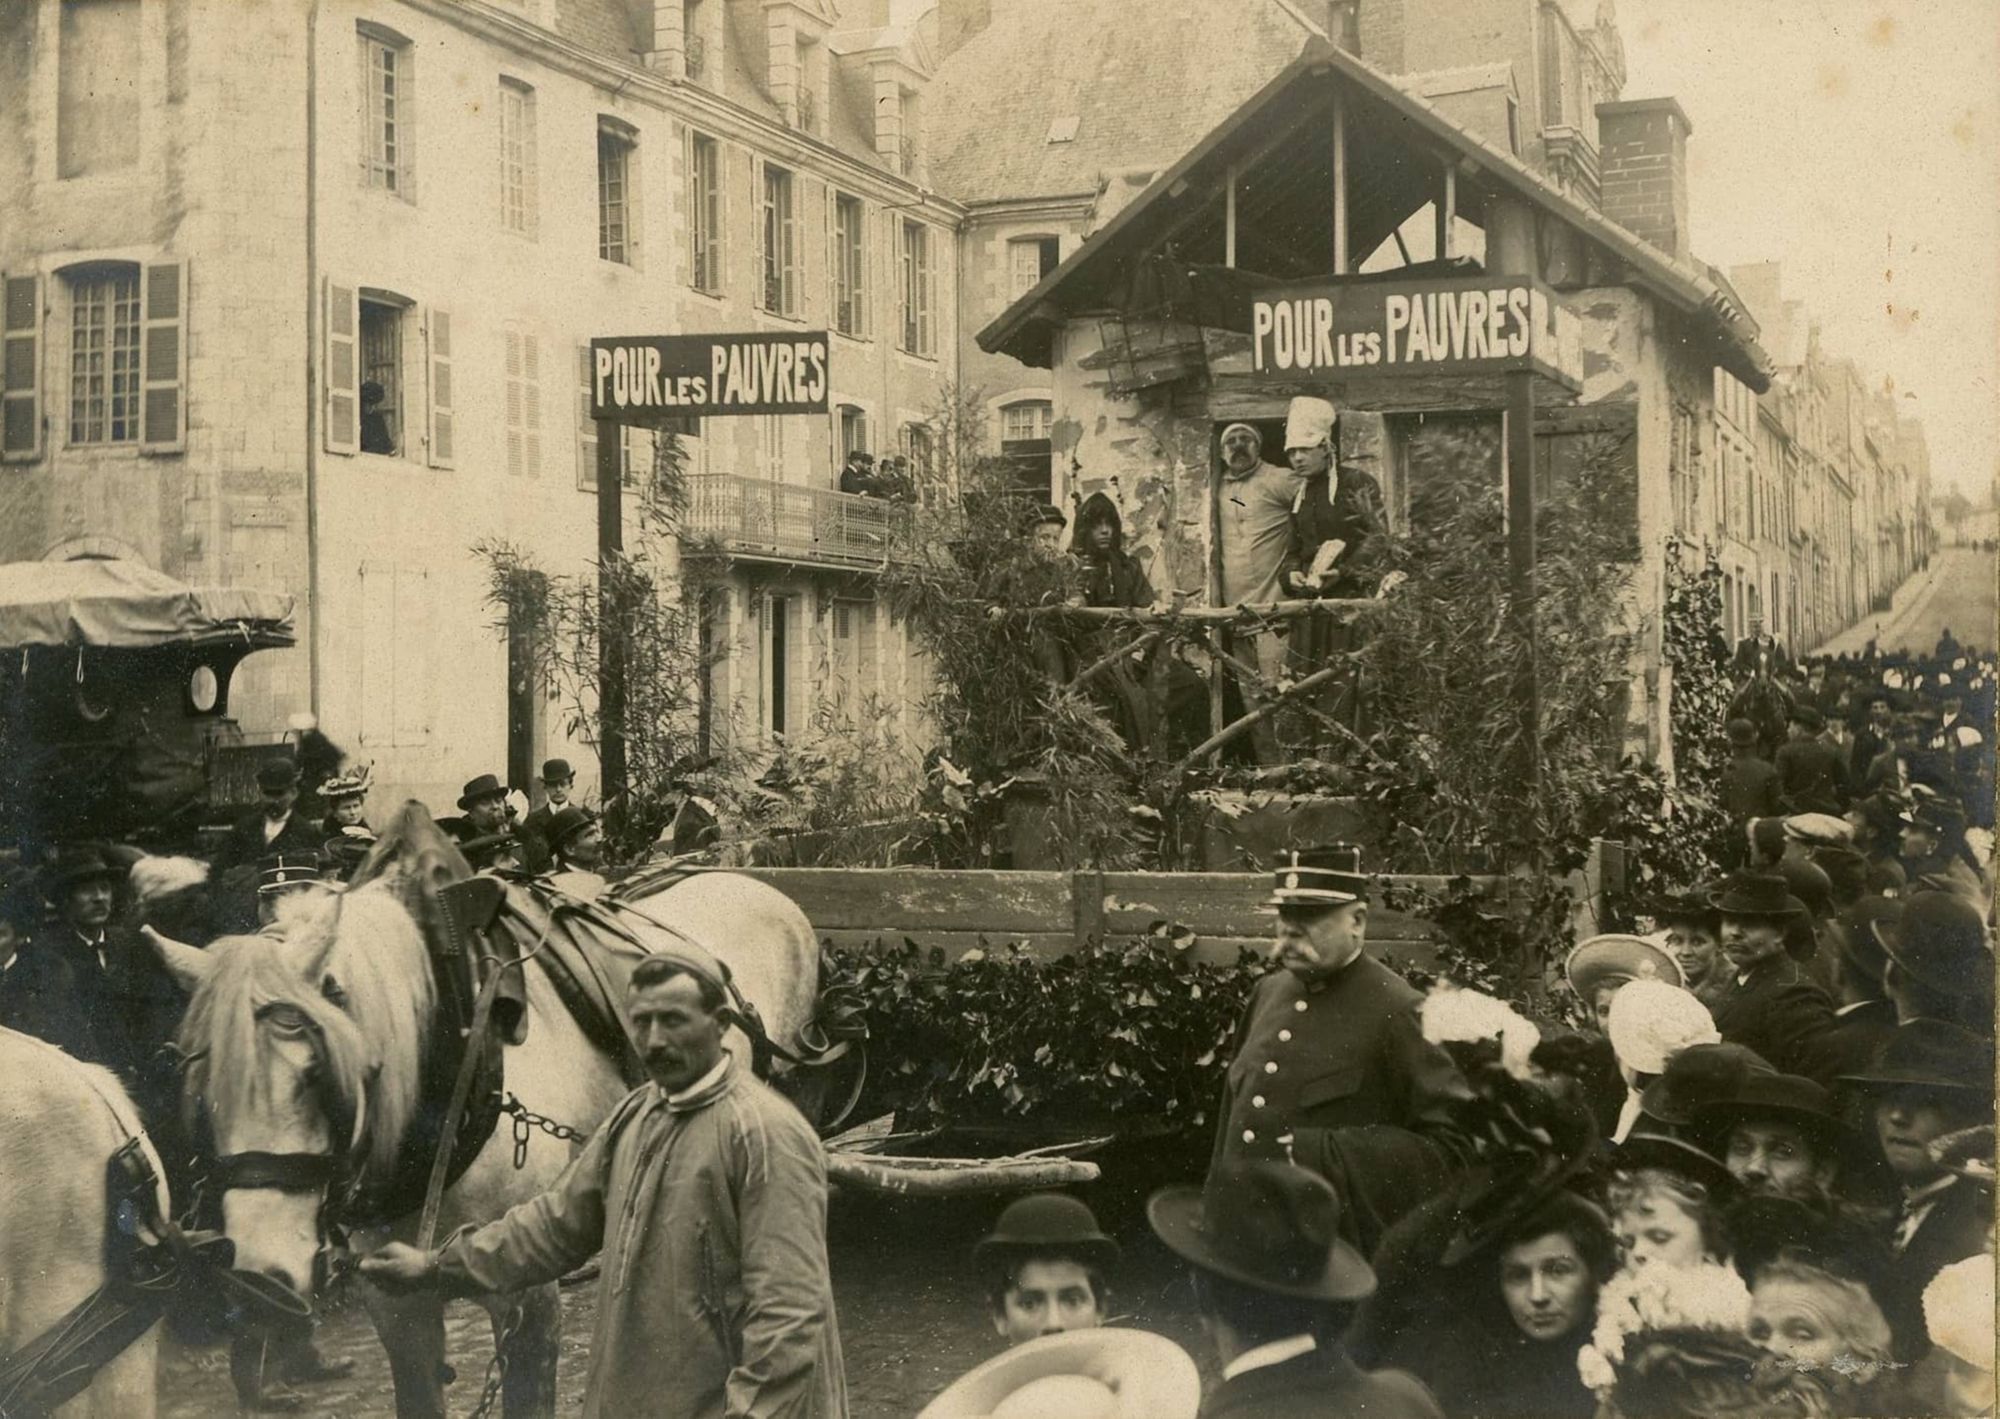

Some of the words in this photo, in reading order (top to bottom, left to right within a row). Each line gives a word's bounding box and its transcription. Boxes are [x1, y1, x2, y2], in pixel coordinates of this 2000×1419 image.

[1253, 298, 1335, 370] POUR
[1337, 332, 1382, 366] LES
[1385, 287, 1529, 363] PAUVRES
[595, 346, 663, 407] POUR
[664, 376, 708, 406] LES
[711, 342, 826, 404] PAUVRES
